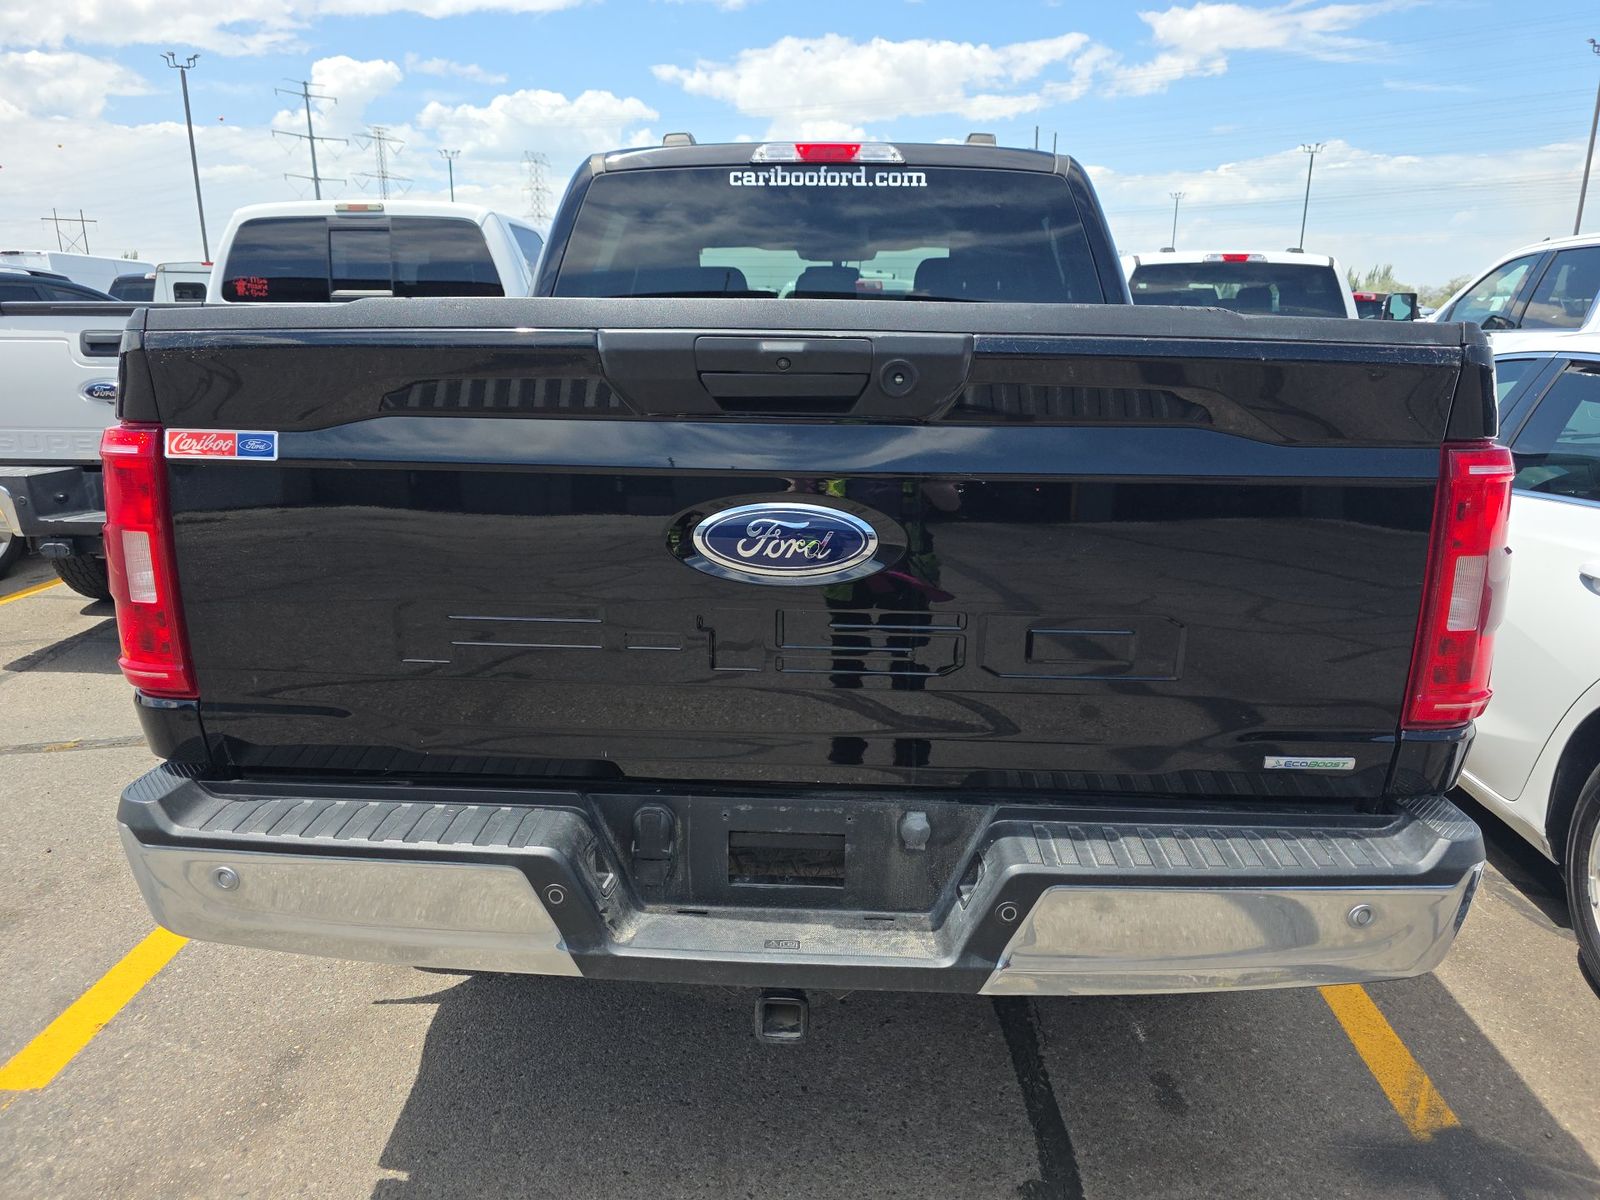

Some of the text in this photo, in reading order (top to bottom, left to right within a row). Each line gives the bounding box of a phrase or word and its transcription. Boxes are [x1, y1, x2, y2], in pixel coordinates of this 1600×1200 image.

[729, 165, 928, 187] caribooford.com
[170, 432, 266, 454] Cariboo Ford
[736, 518, 835, 560] Ford
